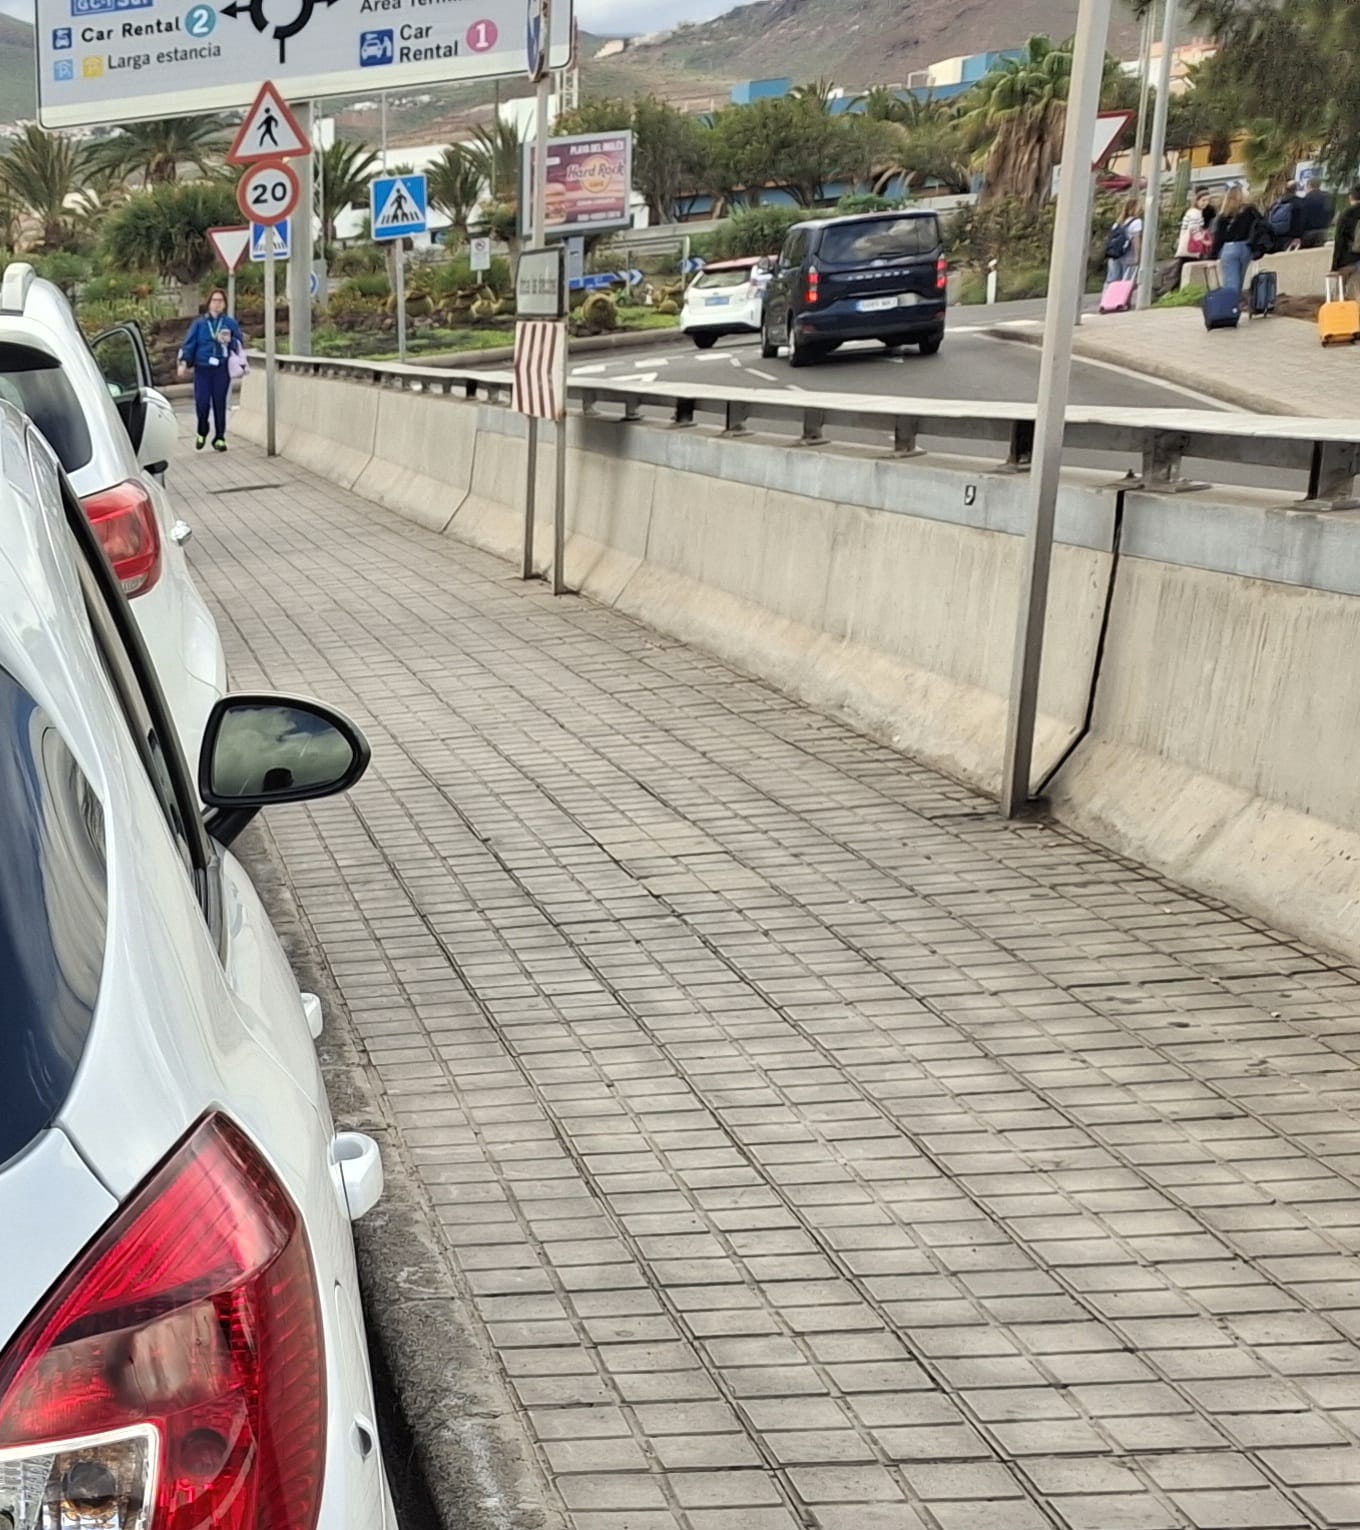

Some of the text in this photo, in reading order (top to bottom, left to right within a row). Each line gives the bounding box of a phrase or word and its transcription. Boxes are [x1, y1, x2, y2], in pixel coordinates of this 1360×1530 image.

[81, 17, 181, 43] Car Rental
[192, 10, 209, 34] 2
[399, 24, 433, 41] Car
[475, 23, 489, 48] 1
[107, 43, 221, 70] Larga estancia
[399, 40, 459, 63] Rental
[566, 160, 625, 180] Hard Rock
[252, 181, 287, 205] 20
